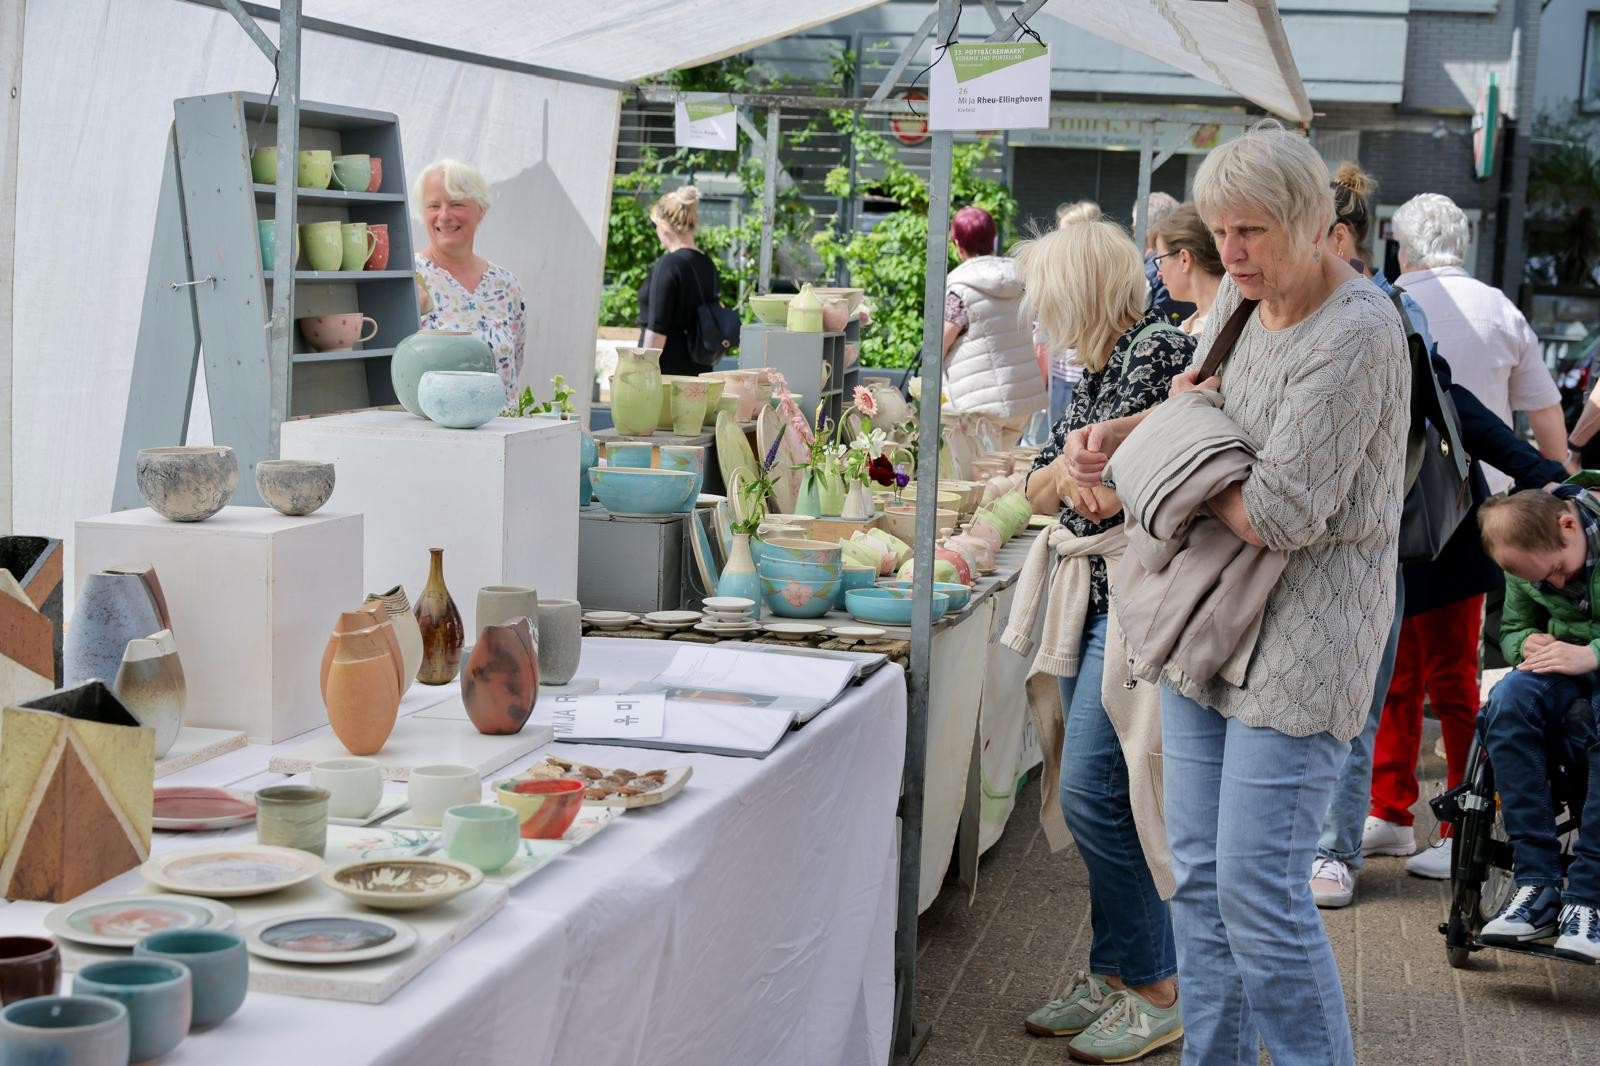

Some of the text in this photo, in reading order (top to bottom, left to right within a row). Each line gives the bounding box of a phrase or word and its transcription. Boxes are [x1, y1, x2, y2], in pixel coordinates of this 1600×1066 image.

[958, 87, 968, 95] 26
[976, 96, 1043, 104] Rheu-Ellinghoven
[613, 692, 640, 726] 유미
